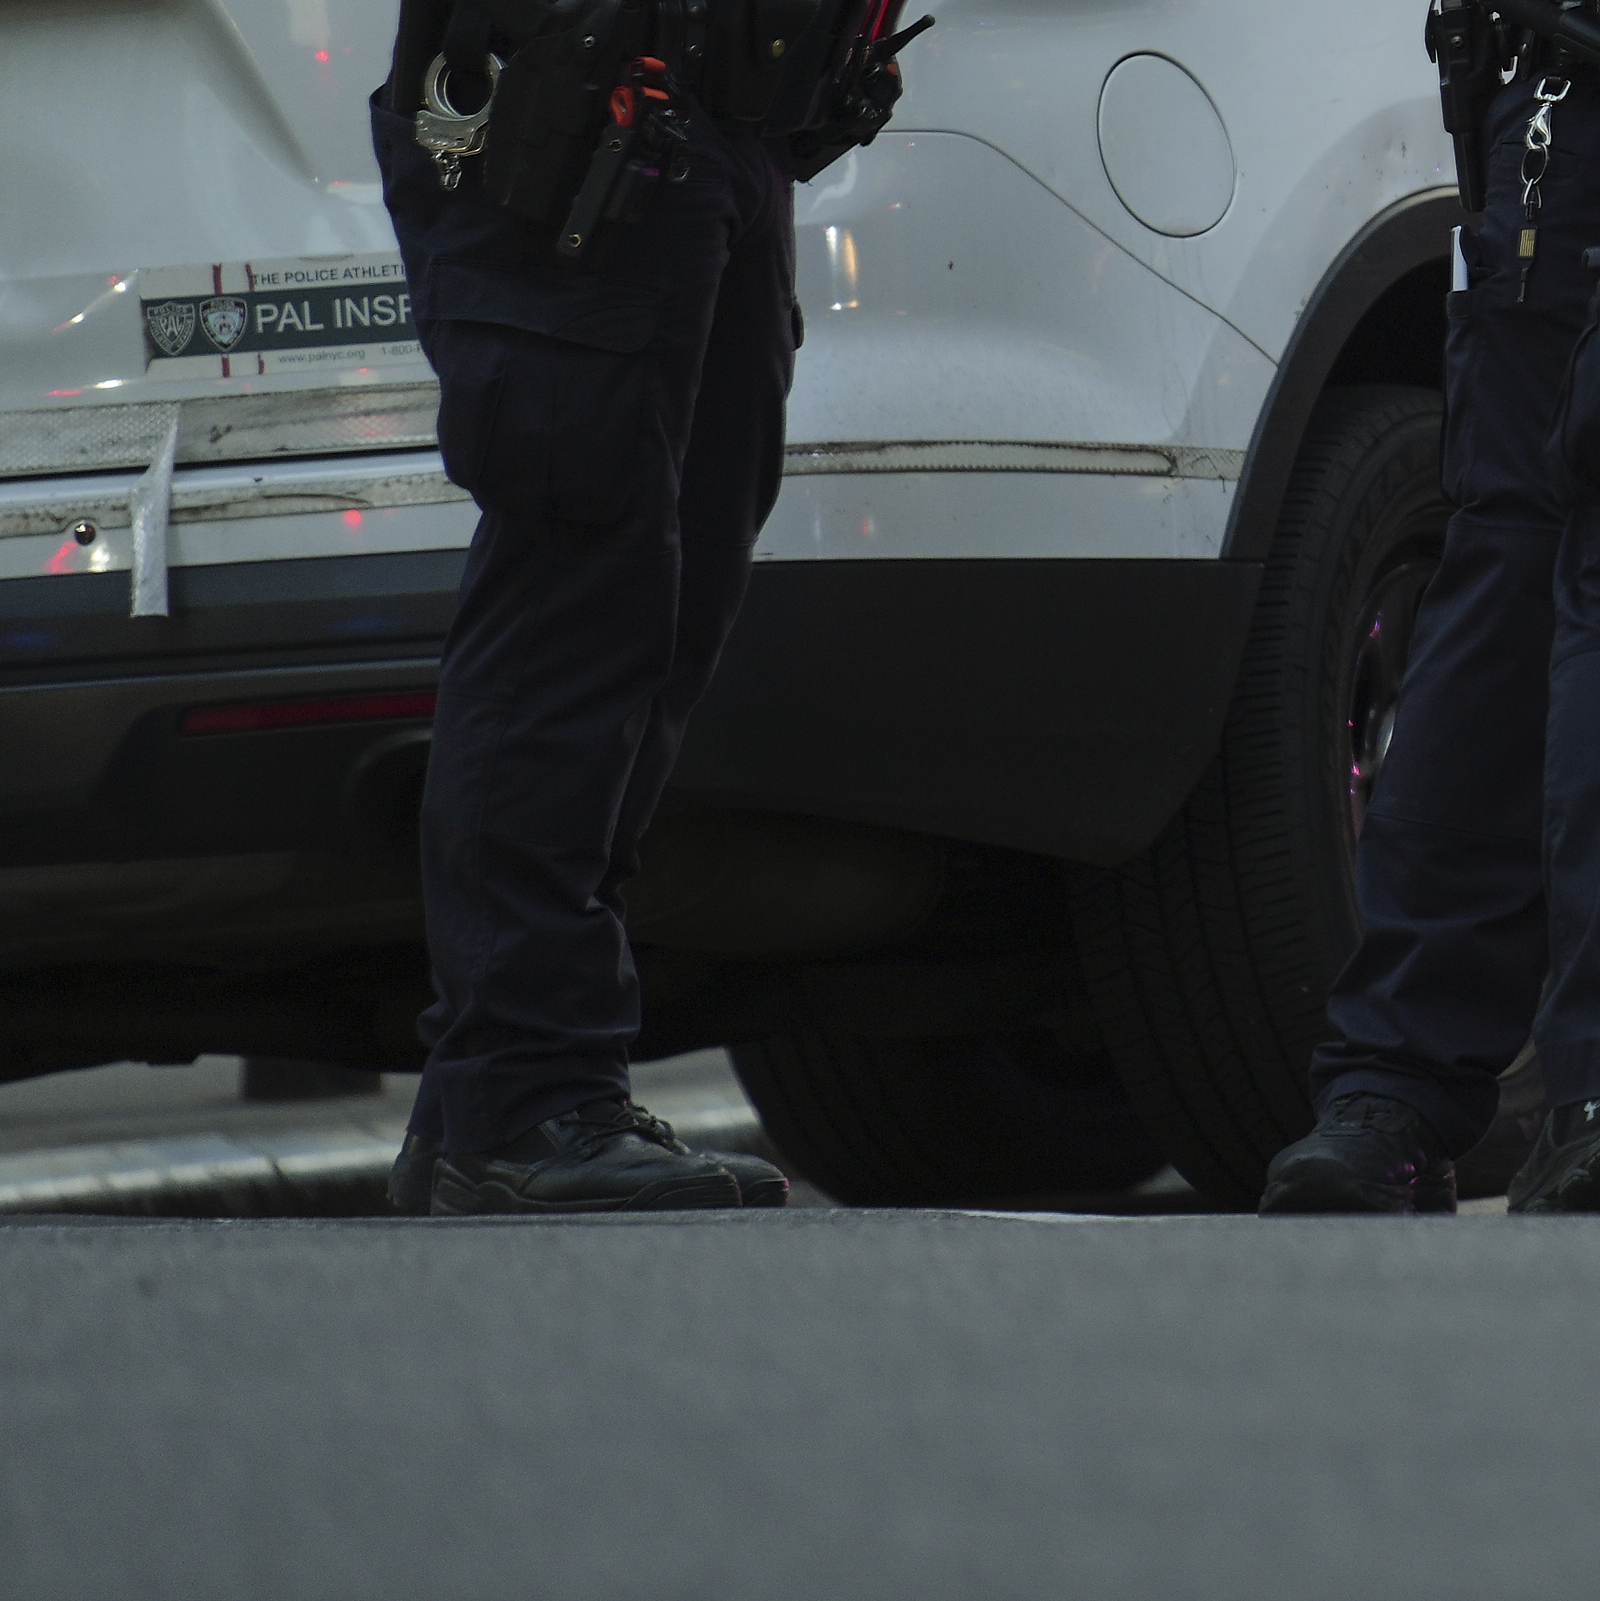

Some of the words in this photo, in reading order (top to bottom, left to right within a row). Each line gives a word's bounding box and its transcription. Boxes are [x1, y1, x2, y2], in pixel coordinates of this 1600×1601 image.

[254, 273, 280, 285] THE
[284, 268, 338, 283] POLICE
[255, 303, 324, 335] PAL
